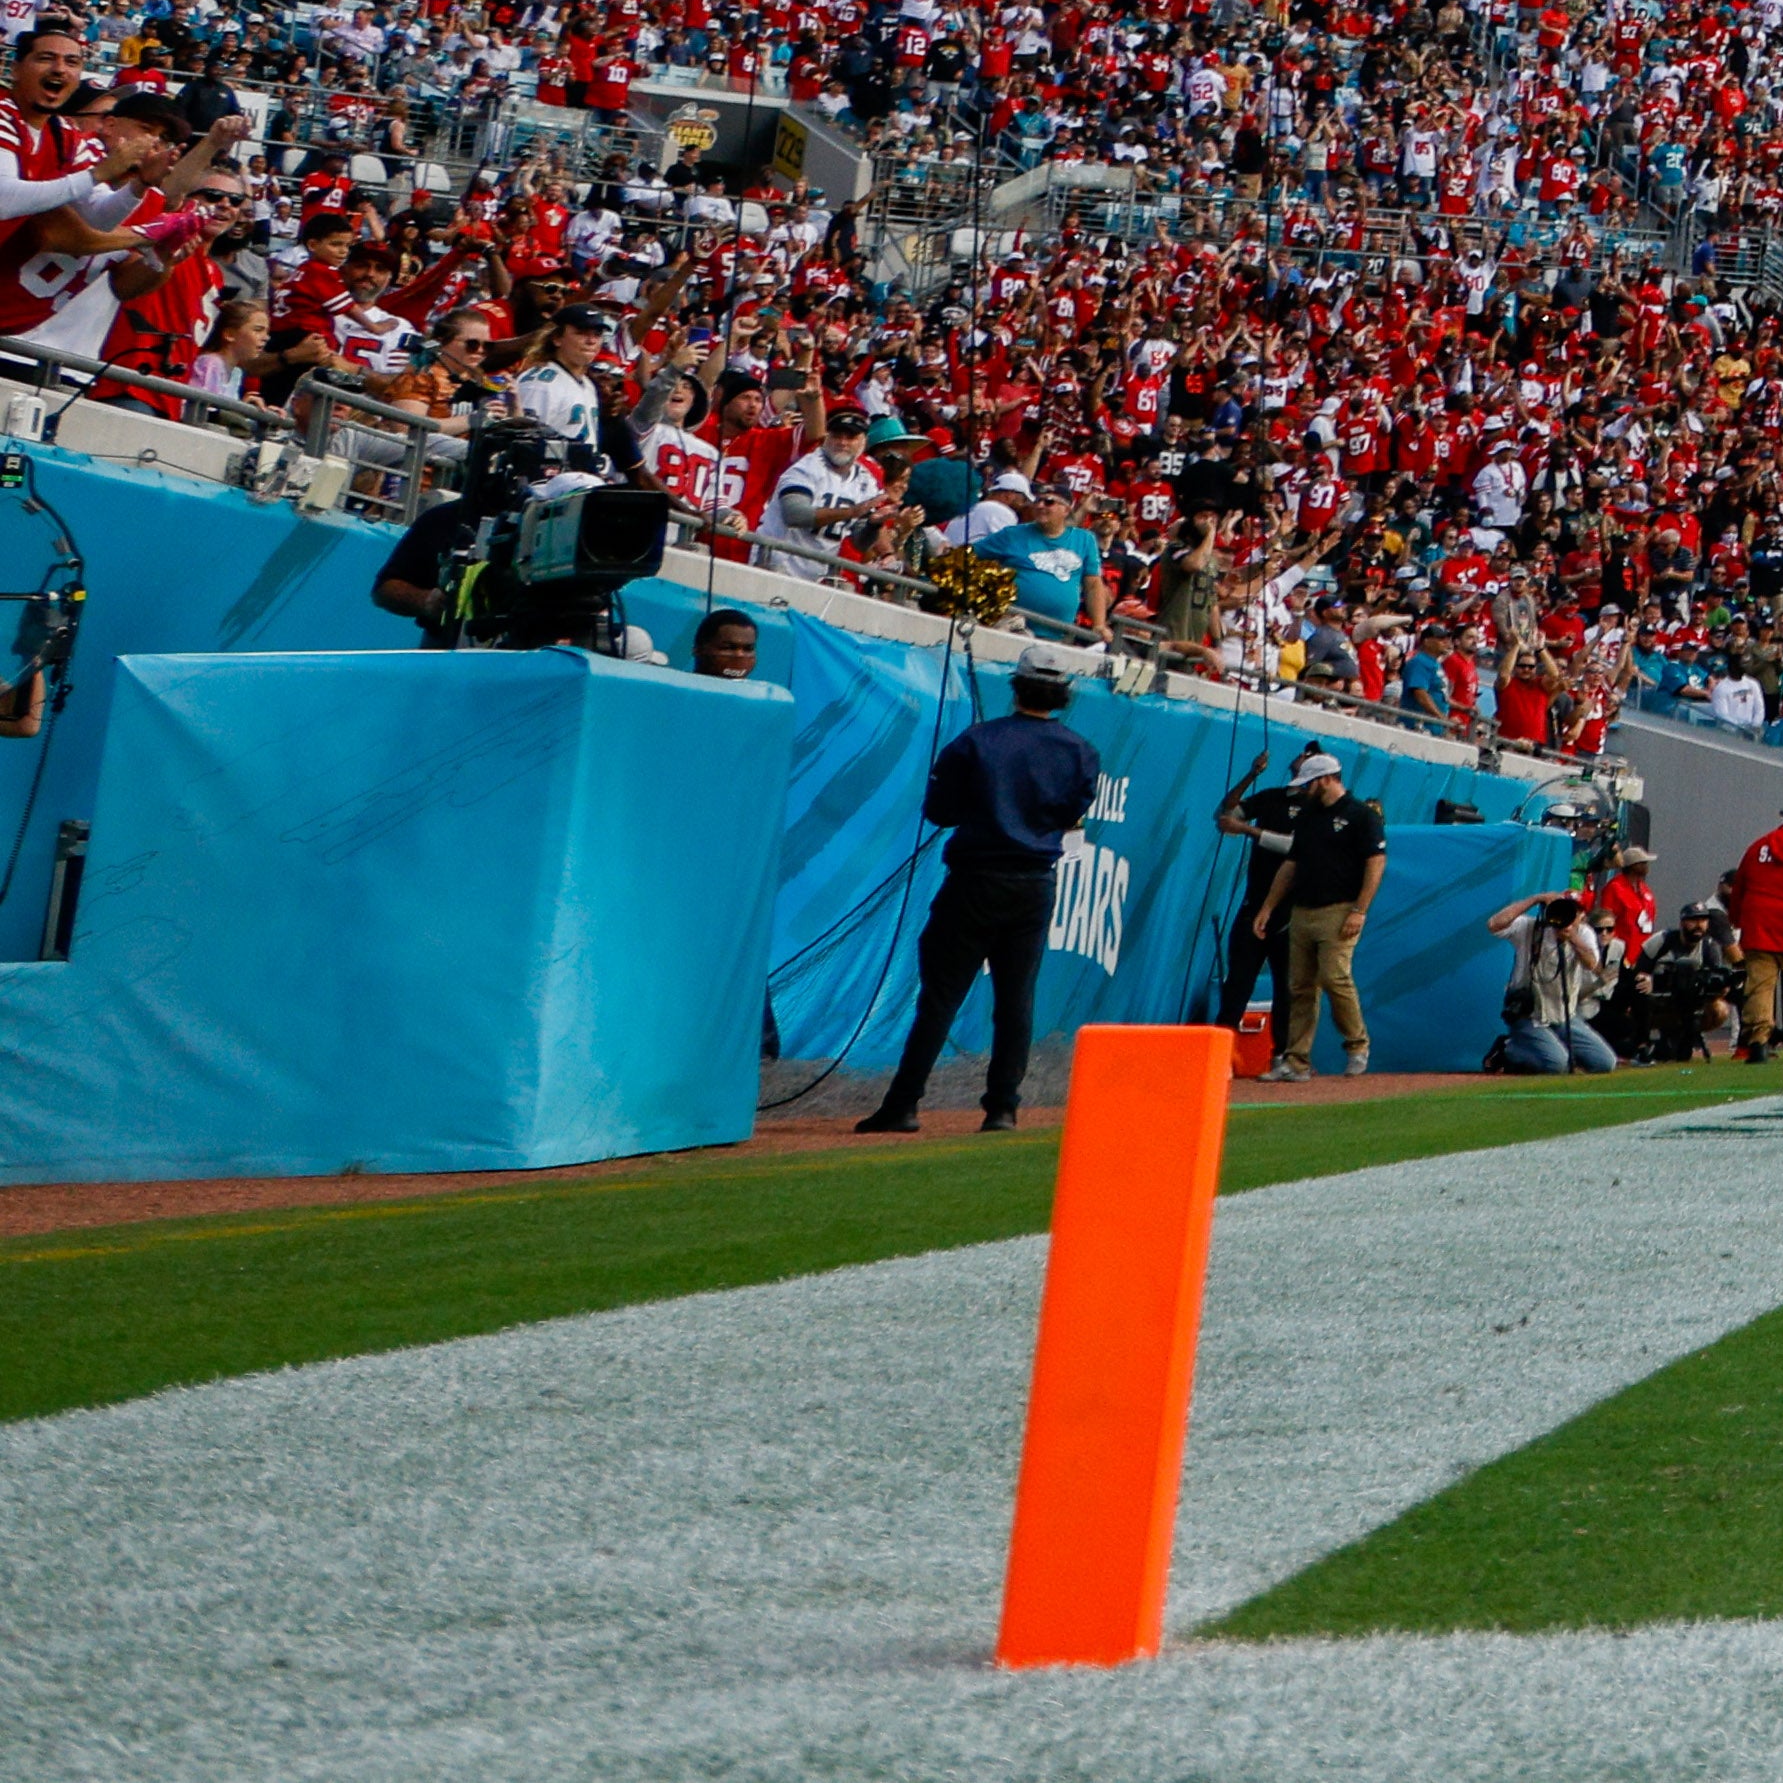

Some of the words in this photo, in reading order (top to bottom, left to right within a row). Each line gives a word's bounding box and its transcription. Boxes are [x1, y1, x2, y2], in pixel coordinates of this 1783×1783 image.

[9, 0, 34, 19] 97
[905, 37, 925, 54] 12
[608, 66, 627, 82] 10
[1190, 84, 1213, 100] 52
[1551, 166, 1570, 181] 80
[1447, 179, 1466, 196] 52
[722, 253, 737, 274] 5
[979, 438, 992, 457] 5
[979, 442, 990, 457] 5
[1349, 437, 1370, 455] 97
[1158, 452, 1183, 474] 85
[657, 444, 717, 508] 80
[1308, 486, 1335, 509] 97
[1141, 495, 1171, 520] 85
